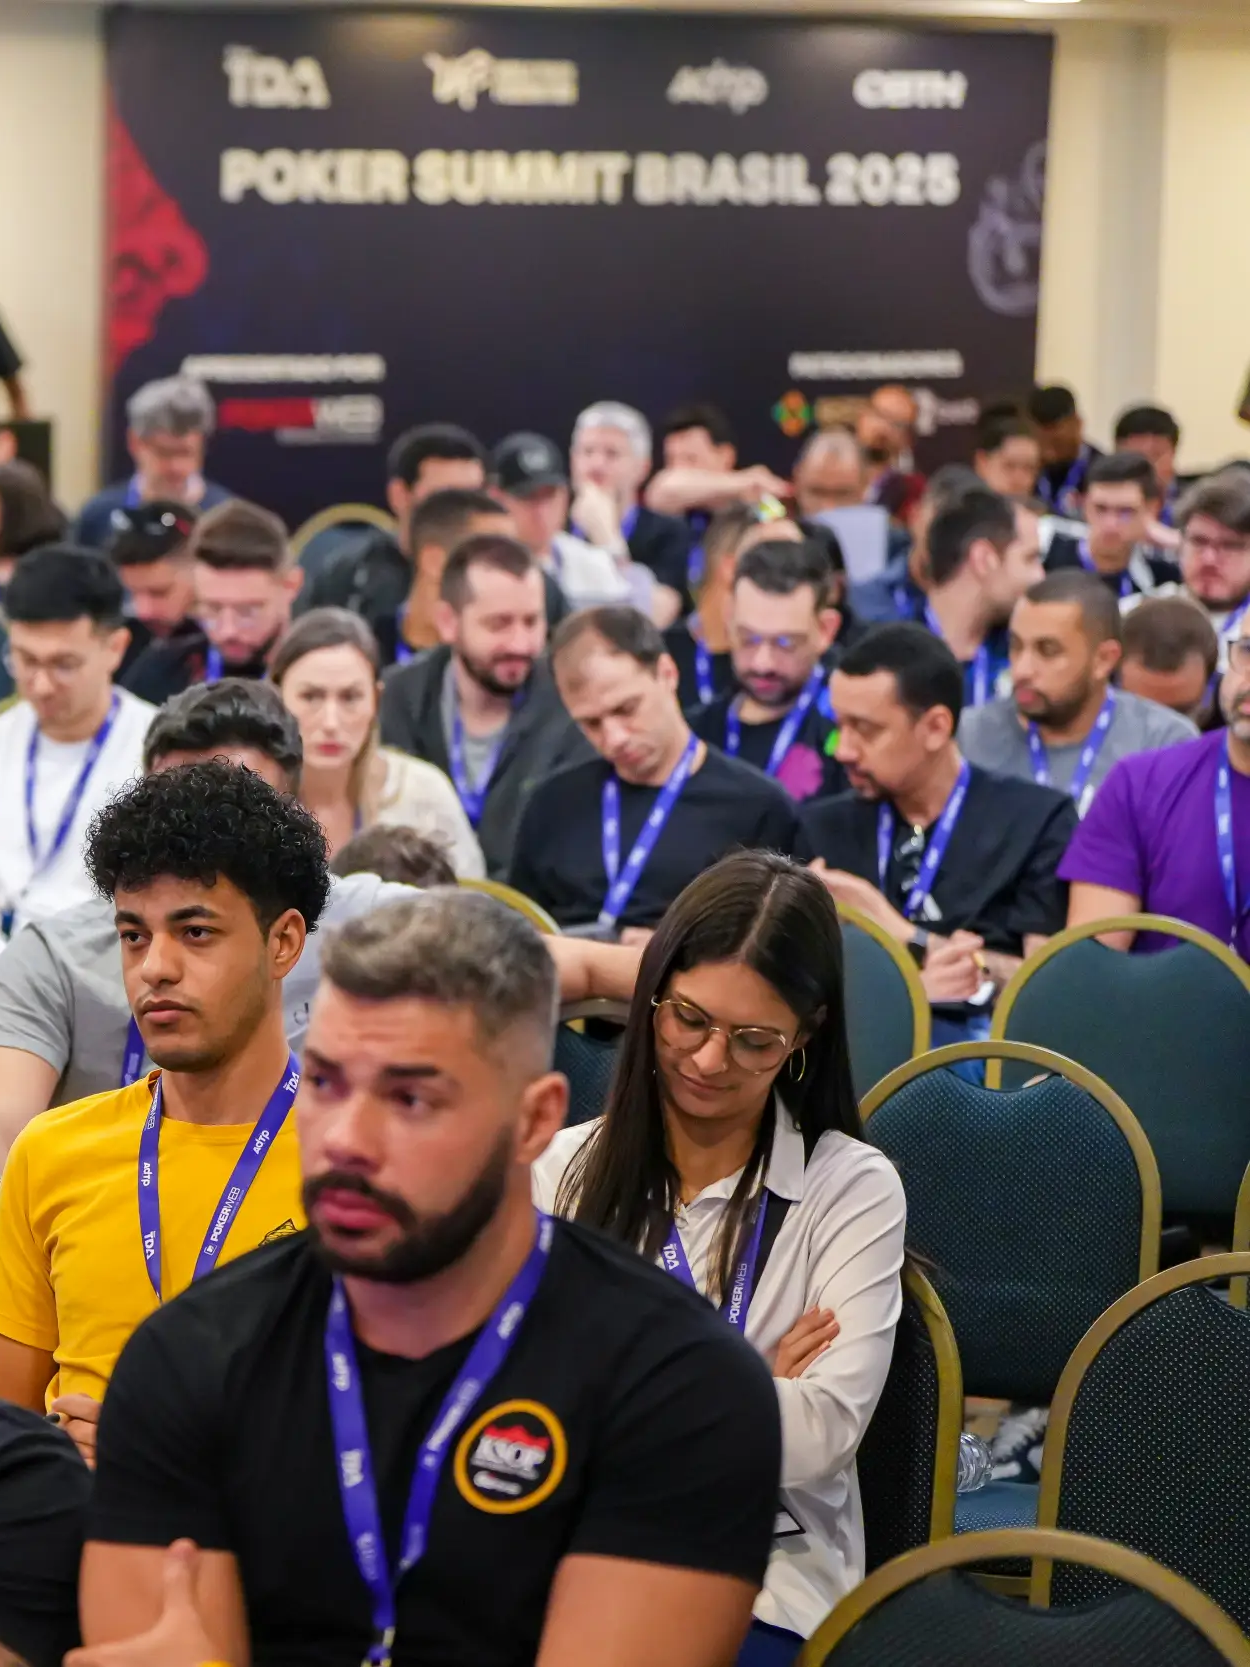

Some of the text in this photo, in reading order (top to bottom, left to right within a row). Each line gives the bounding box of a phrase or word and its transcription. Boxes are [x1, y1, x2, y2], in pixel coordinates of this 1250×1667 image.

[220, 149, 960, 205] POKER SUMMIT BRASIL 2025
[210, 1186, 240, 1242] POKERWEB
[144, 1230, 156, 1260] TDA
[663, 1243, 680, 1270] TDA
[729, 1263, 748, 1324] POKERWEB
